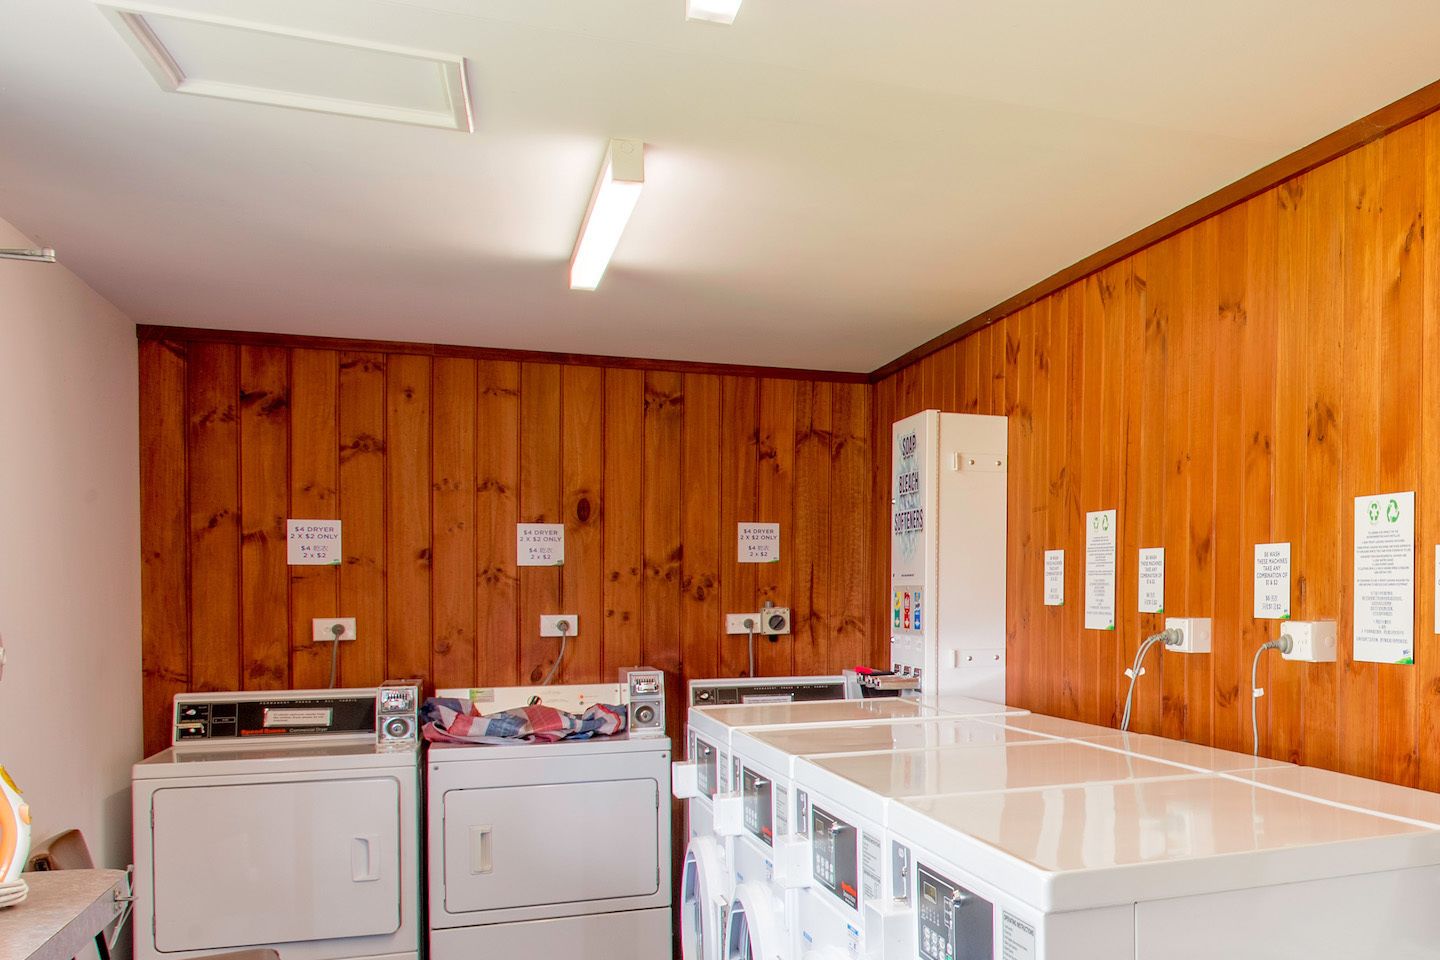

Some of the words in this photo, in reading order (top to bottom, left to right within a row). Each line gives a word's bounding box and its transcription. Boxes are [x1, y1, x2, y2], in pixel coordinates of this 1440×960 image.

[902, 434, 916, 456] SOAP
[899, 471, 919, 494] BLEACH
[895, 509, 923, 532] SOFTENERS
